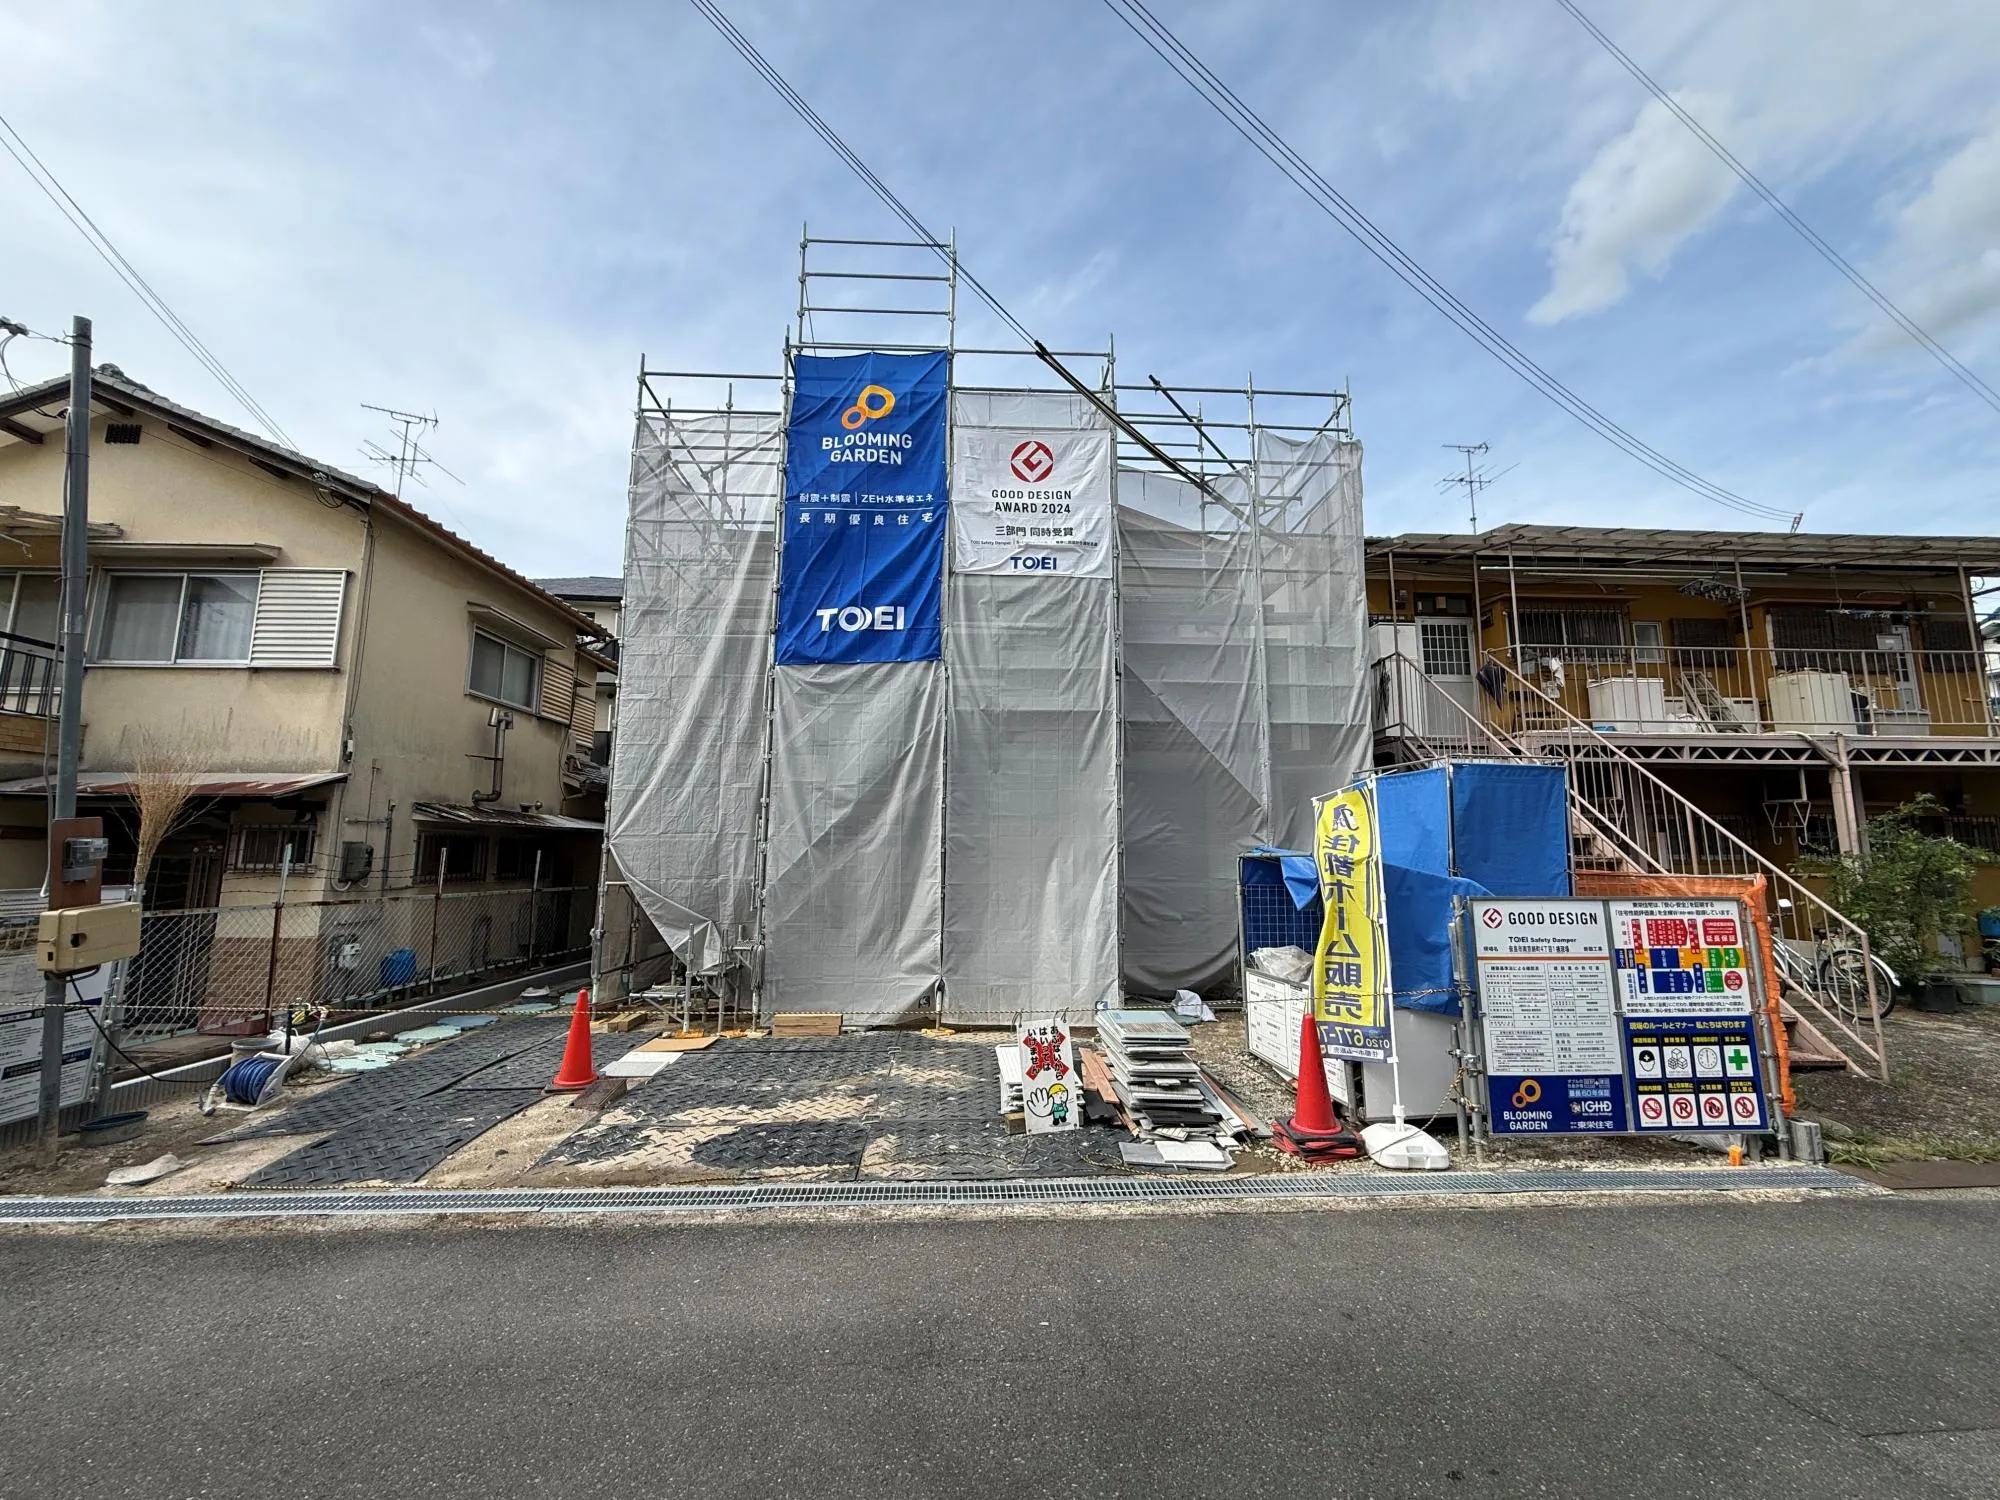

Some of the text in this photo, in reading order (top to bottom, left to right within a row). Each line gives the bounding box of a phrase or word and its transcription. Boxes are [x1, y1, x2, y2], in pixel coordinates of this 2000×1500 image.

[822, 432, 913, 450] BLOOMING
[830, 449, 902, 465] GARDEN
[861, 493, 934, 504] ZEH水準省エネ
[991, 489, 1072, 500] GOOD DESIGN
[994, 502, 1071, 514] AWARD 2024
[995, 525, 1074, 537] 三部門 同時受賞
[1010, 557, 1057, 570] TOEI
[816, 606, 905, 632] TOEI
[1508, 912, 1598, 925] GOOD DESIGN
[1629, 1020, 1747, 1030] 現場のルールとマナー 私たちは守ります
[1027, 1028, 1040, 1076] いけません
[1039, 1026, 1051, 1071] はいっては
[1050, 1026, 1064, 1080] あぶないから
[1503, 1111, 1552, 1120] BLOOMING
[1509, 1121, 1548, 1130] GARDEN
